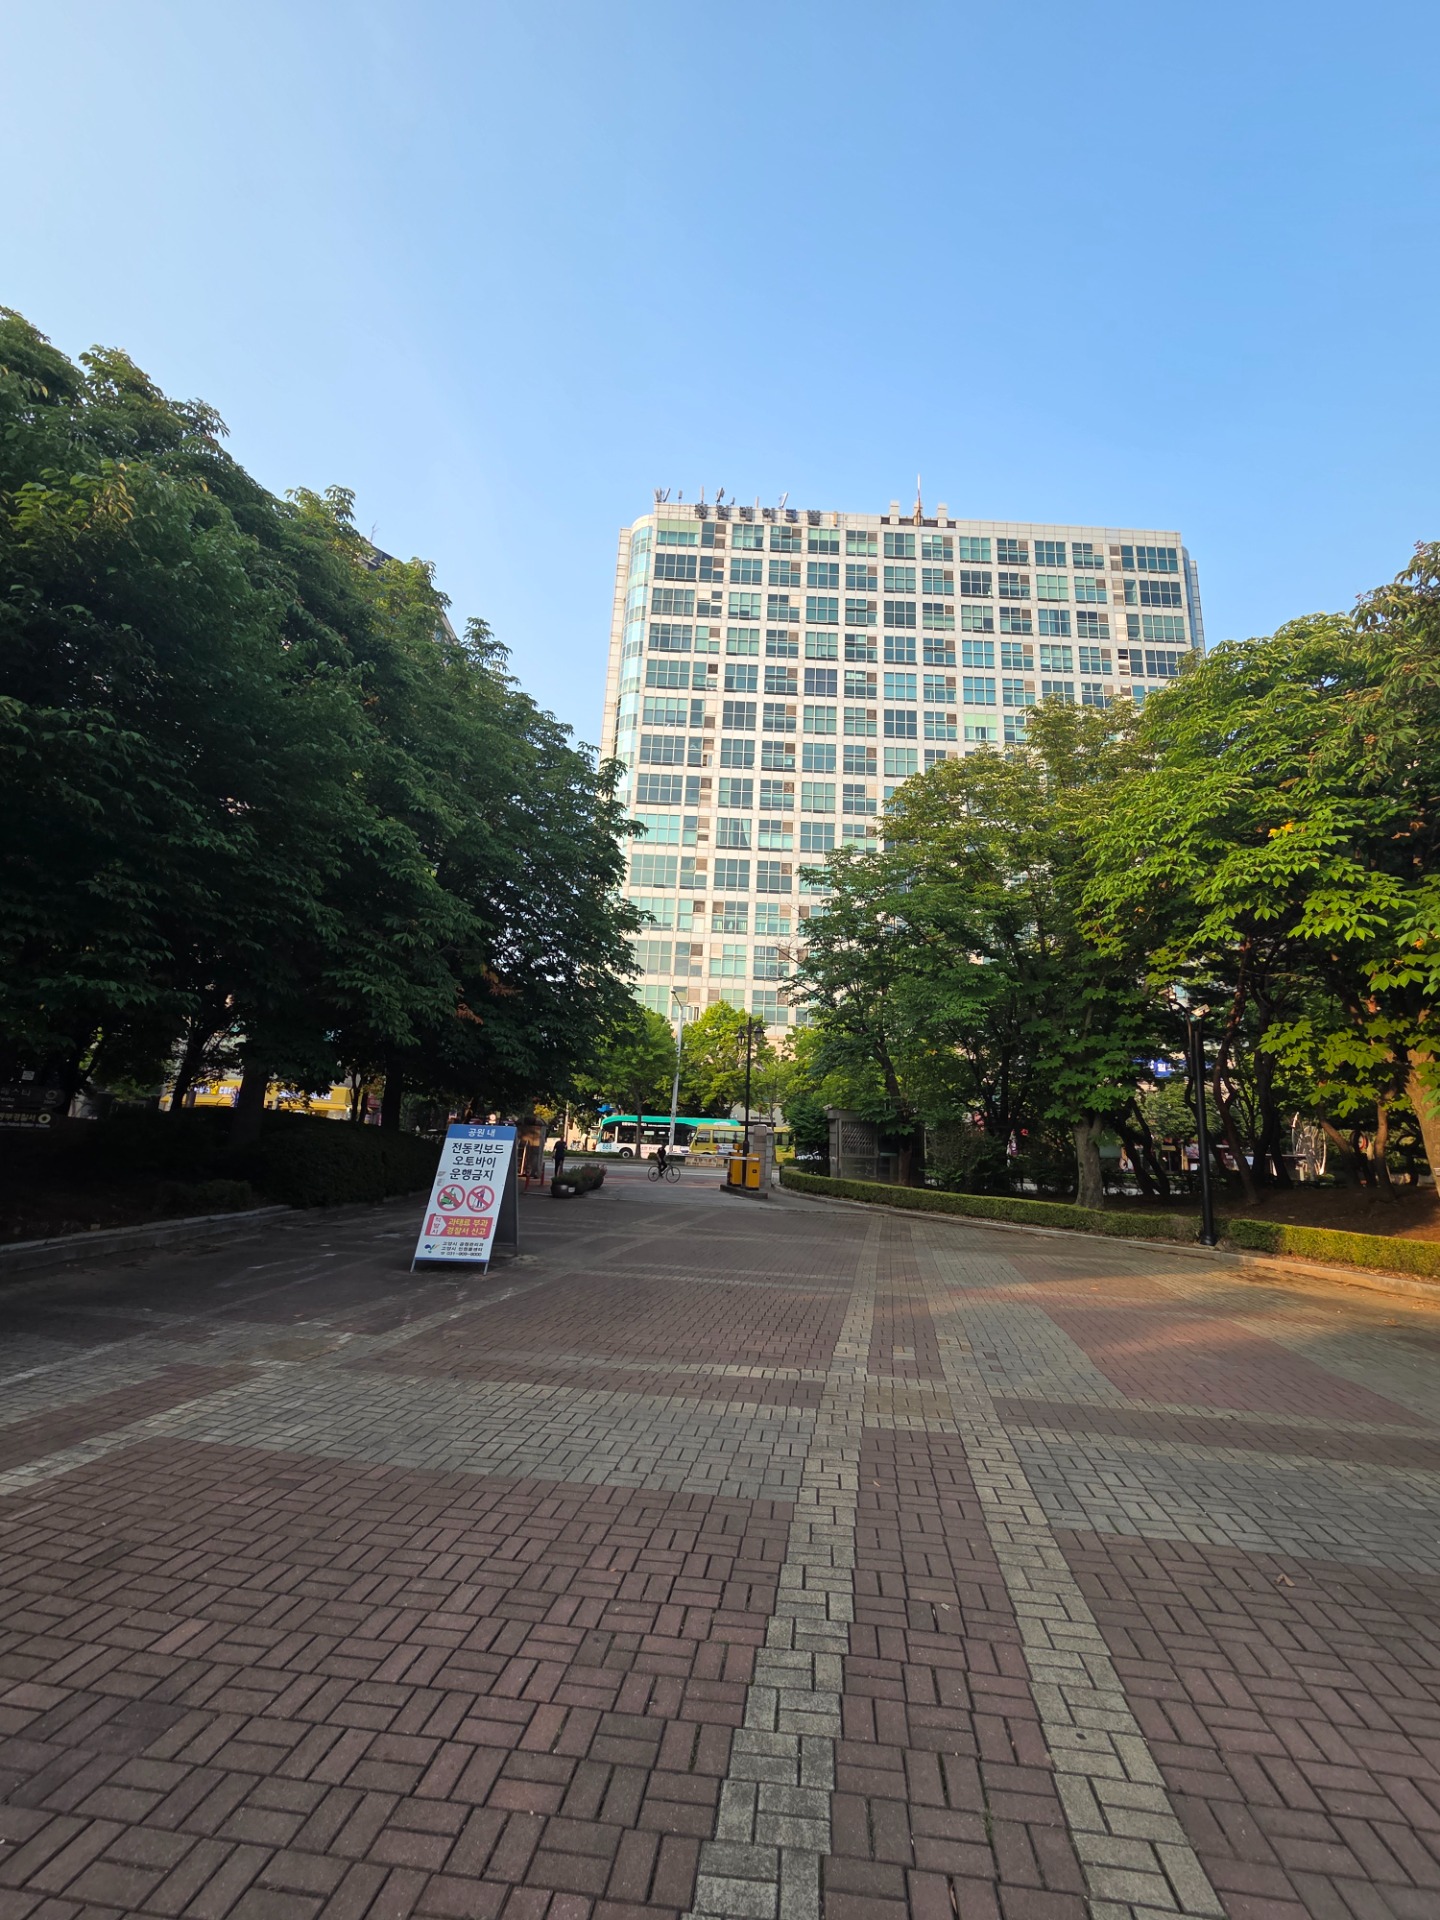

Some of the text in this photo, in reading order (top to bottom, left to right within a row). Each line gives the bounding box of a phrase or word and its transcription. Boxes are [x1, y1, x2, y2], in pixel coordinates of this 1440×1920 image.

[468, 1128, 496, 1138] 공원 내
[452, 1142, 504, 1155] 전동킥보드
[452, 1155, 497, 1168] 오토바이
[449, 1168, 493, 1181] 운행금지
[448, 1218, 488, 1227] 과태료 부과
[447, 1227, 486, 1236] 경찰서 신고
